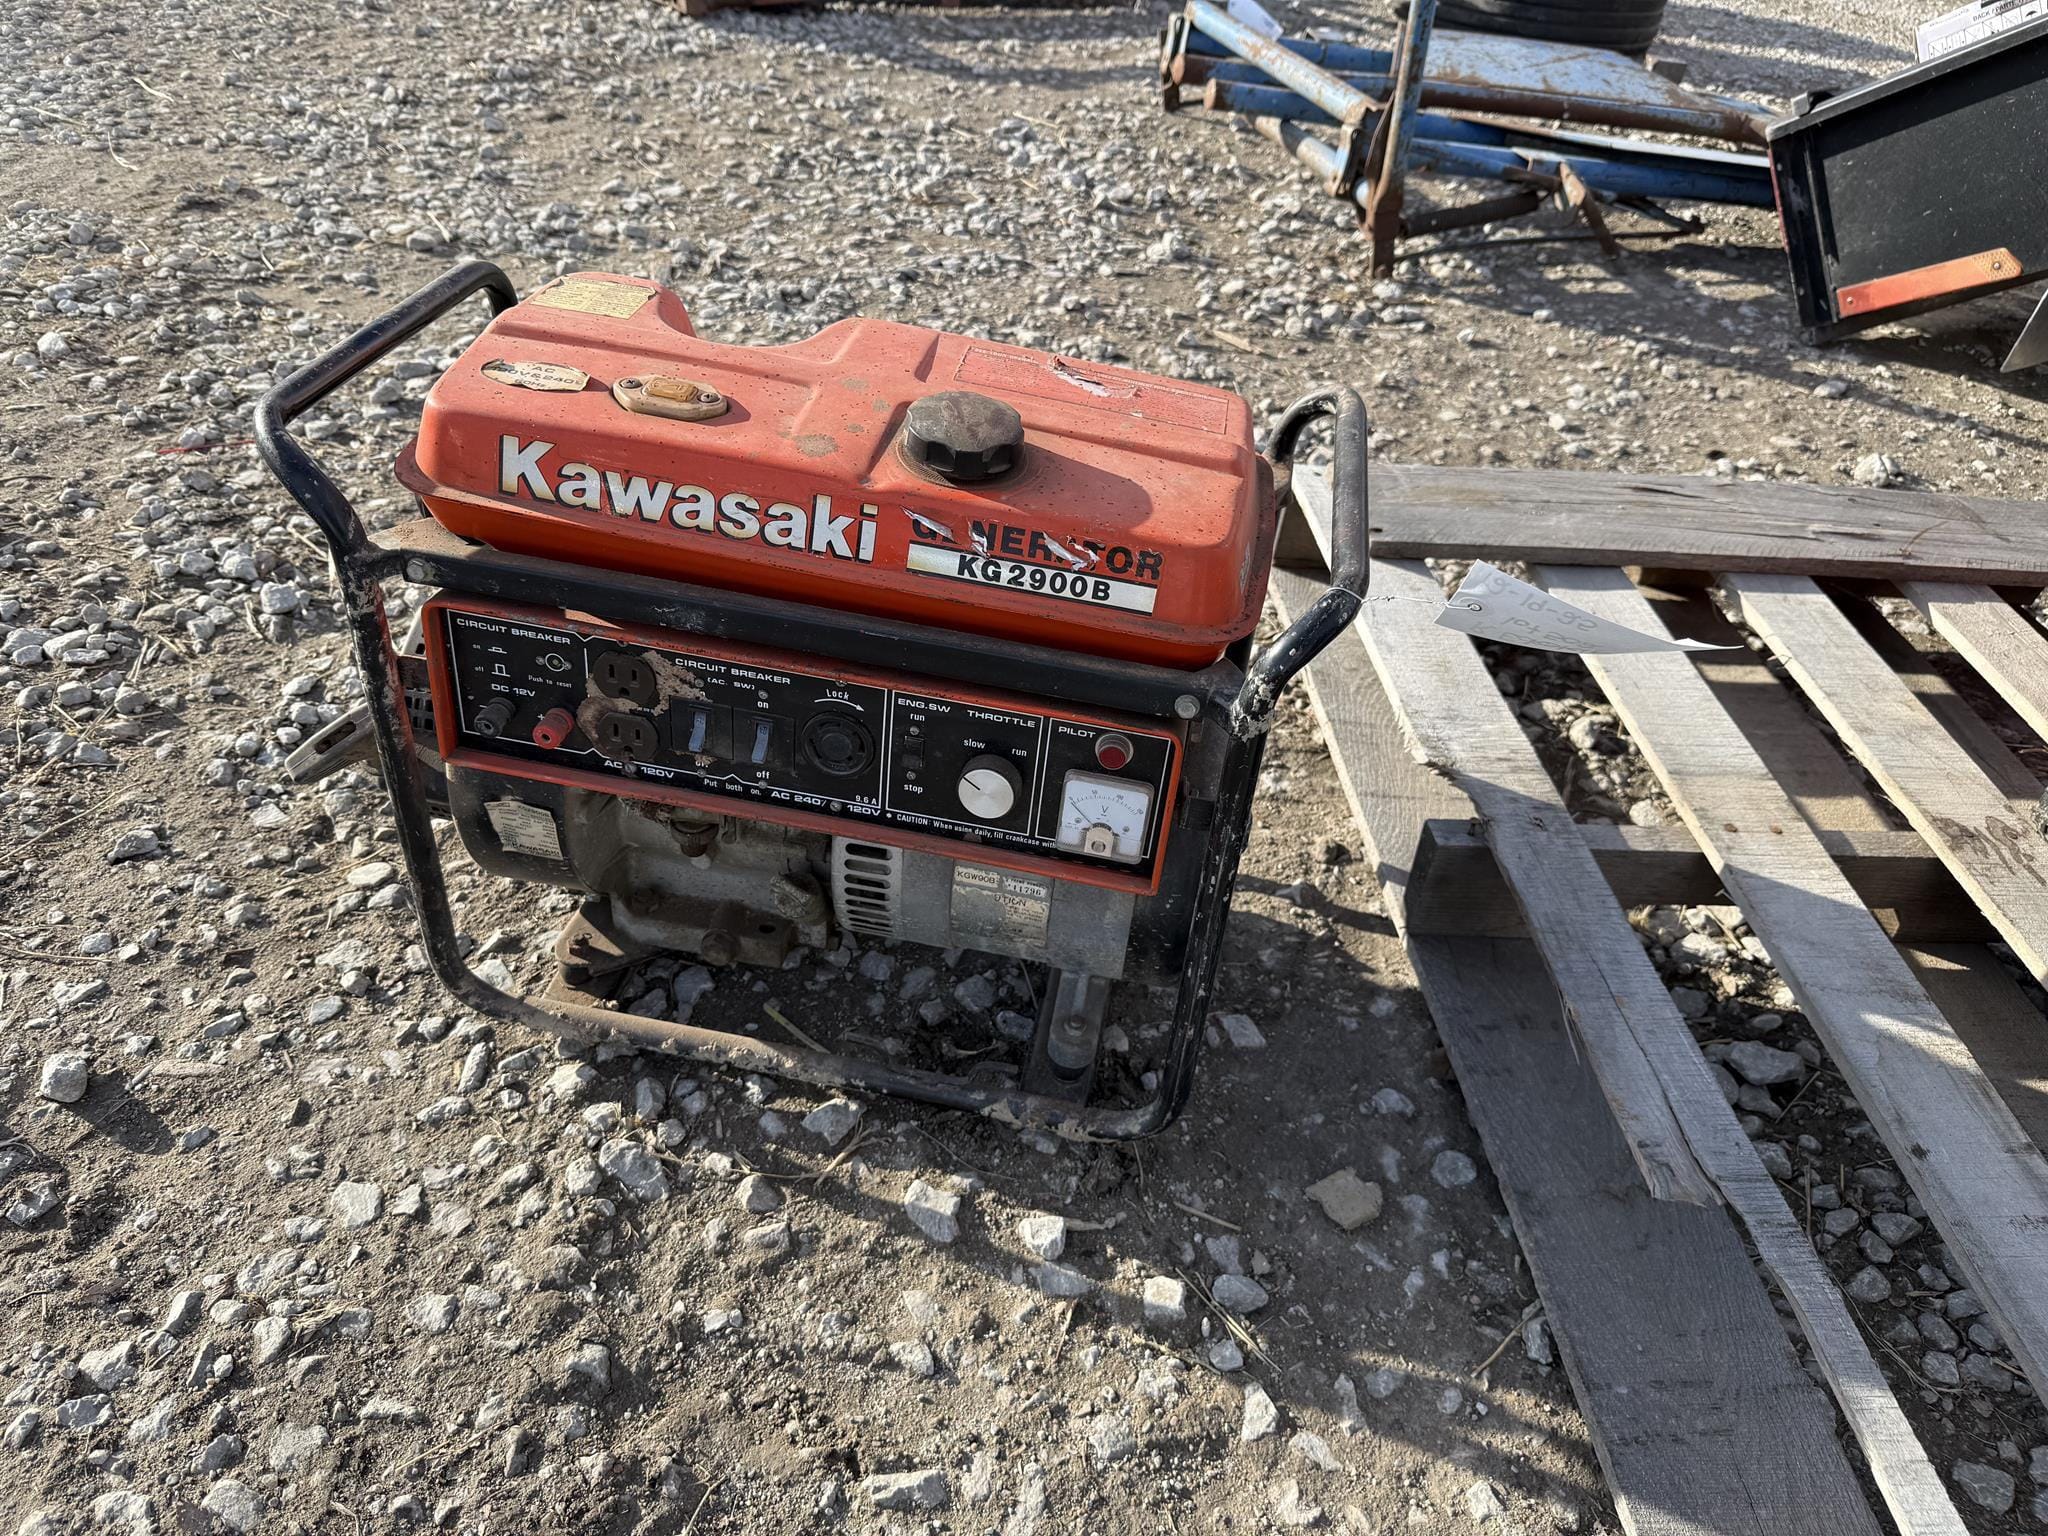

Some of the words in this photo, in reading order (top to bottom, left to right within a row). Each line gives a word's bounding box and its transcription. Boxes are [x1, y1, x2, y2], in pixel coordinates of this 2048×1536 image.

[533, 365, 555, 374] AC
[499, 433, 879, 563] Kawasaki
[957, 554, 1111, 602] KG2900B
[456, 618, 508, 634] CIRCUIT
[511, 628, 571, 645] BREAKER
[675, 658, 727, 673] CIRCUIT
[730, 668, 791, 685] BREAKER
[528, 674, 544, 685] Push
[556, 679, 572, 689] reset
[491, 683, 510, 693] DC
[512, 687, 536, 698] 12V
[826, 688, 850, 700] Lock
[757, 701, 769, 709] on
[898, 698, 951, 713] ENG.SW
[910, 713, 925, 722] run
[967, 710, 1036, 728] THROTTLE
[1058, 726, 1096, 739] PILOT
[963, 737, 986, 750] slow
[1011, 747, 1027, 757] run
[604, 759, 623, 769] AC
[640, 766, 675, 779] 120V
[756, 770, 770, 780] off
[704, 778, 718, 788] Put
[725, 782, 743, 793] both
[903, 783, 923, 794] stop
[771, 791, 790, 801] AC
[847, 804, 881, 817] 120V
[1101, 805, 1110, 813] V
[933, 820, 953, 831] When
[1006, 833, 1040, 847] crankcase
